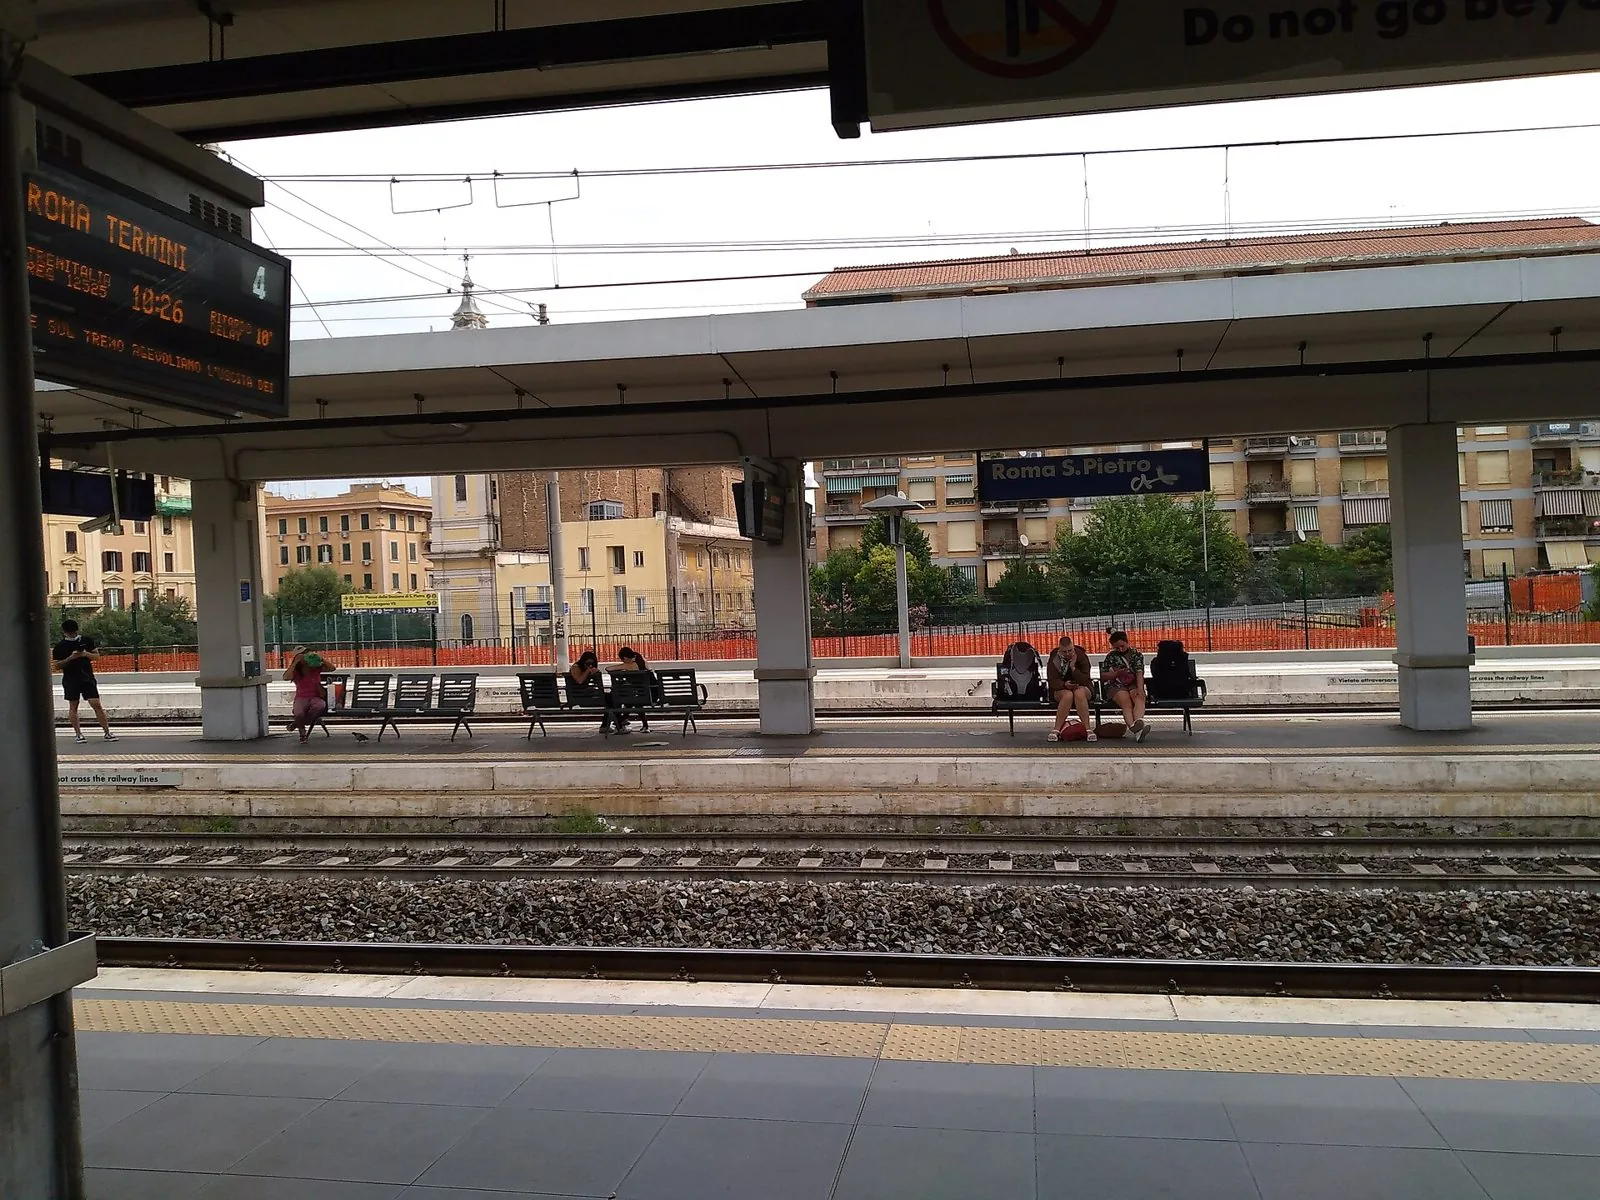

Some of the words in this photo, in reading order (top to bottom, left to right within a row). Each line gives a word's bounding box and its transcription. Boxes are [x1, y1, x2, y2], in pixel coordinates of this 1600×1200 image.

[1183, 6, 1255, 47] Do
[1269, 0, 1358, 39] not
[1375, 0, 1446, 39] go
[28, 181, 92, 234] ROMA
[105, 214, 189, 273] TERMINI
[251, 265, 267, 301] 4
[131, 284, 185, 325] 10:26
[991, 463, 1056, 480] Roma
[1061, 459, 1081, 476] S.
[1083, 457, 1151, 474] Pietro
[92, 774, 106, 783] the
[107, 774, 137, 785] railway
[139, 774, 159, 783] lines
